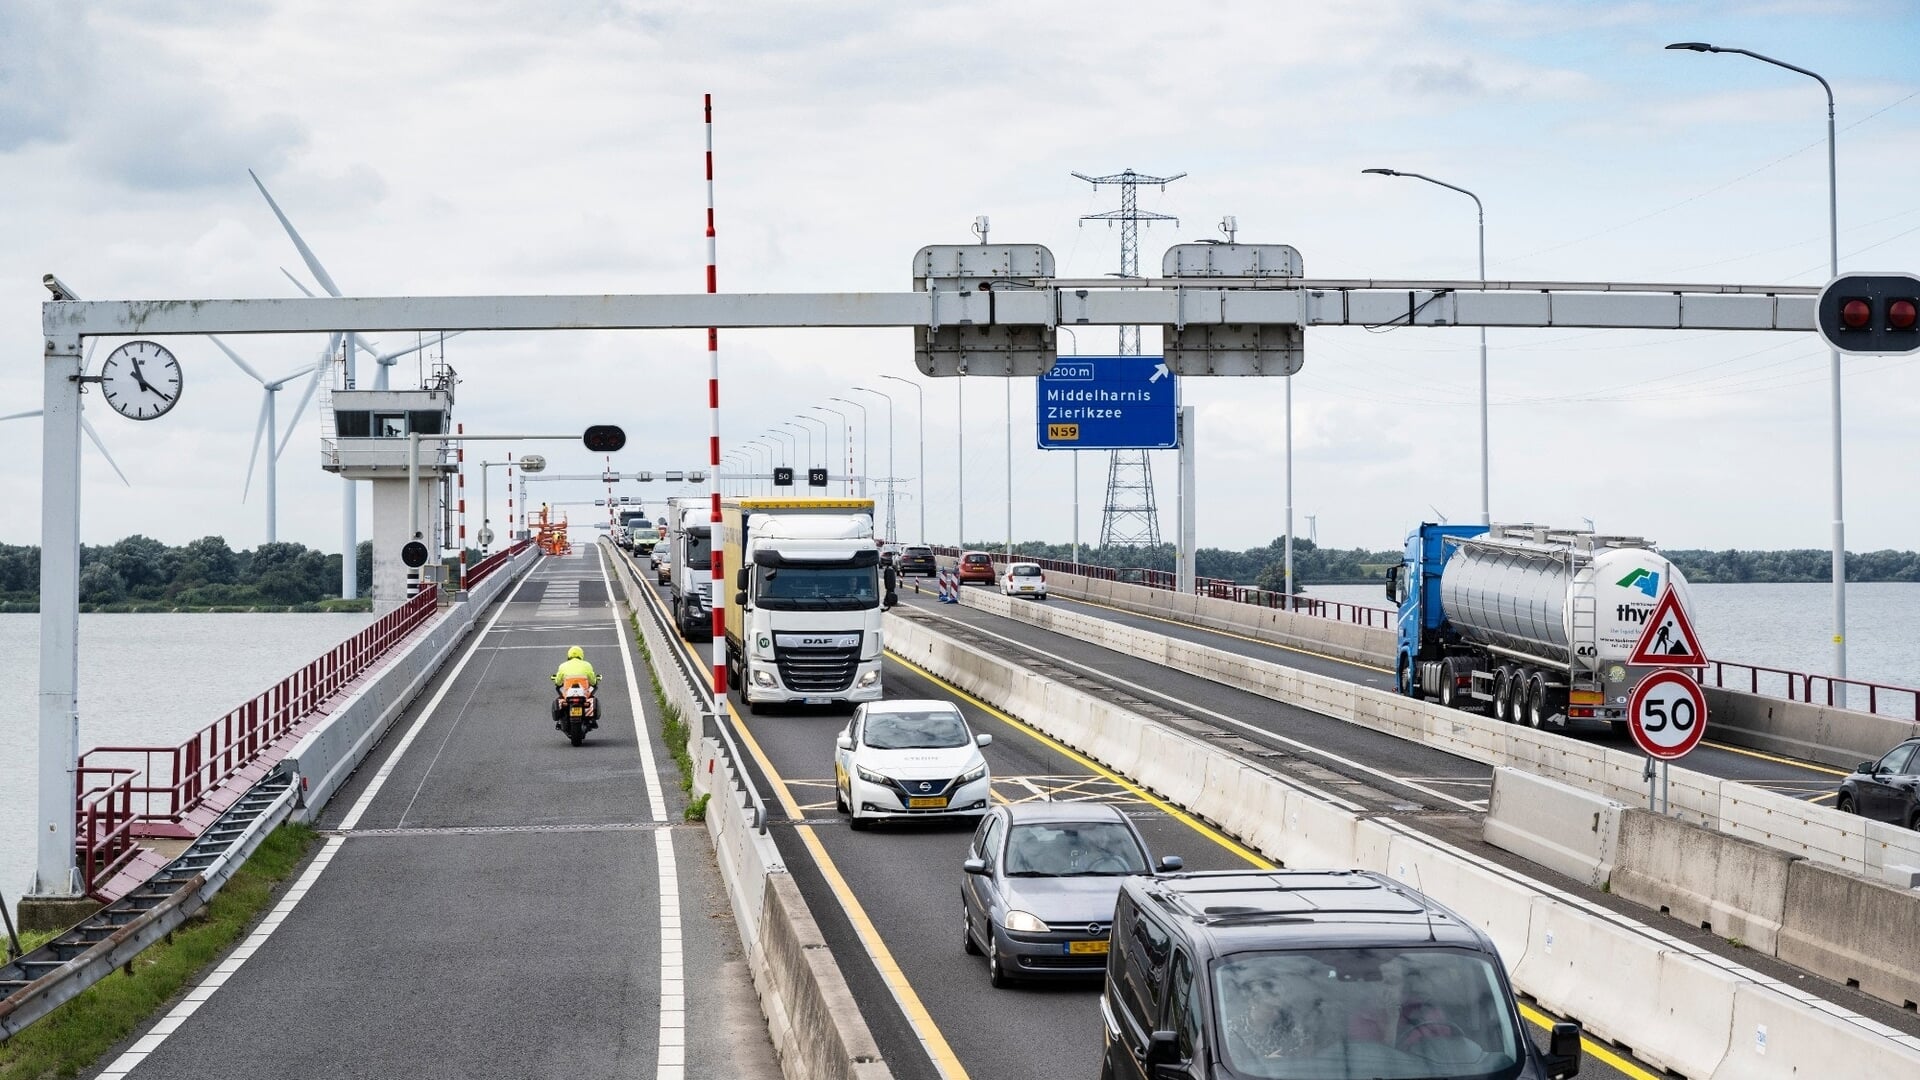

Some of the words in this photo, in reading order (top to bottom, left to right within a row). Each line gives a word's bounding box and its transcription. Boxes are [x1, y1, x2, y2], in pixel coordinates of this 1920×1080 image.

[1079, 368, 1090, 376] m
[1047, 389, 1151, 401] Middelharnis
[1047, 407, 1122, 418] Zierikzee
[1050, 427, 1077, 437] N59
[1577, 646, 1598, 657] 40
[1645, 698, 1695, 732] 50
